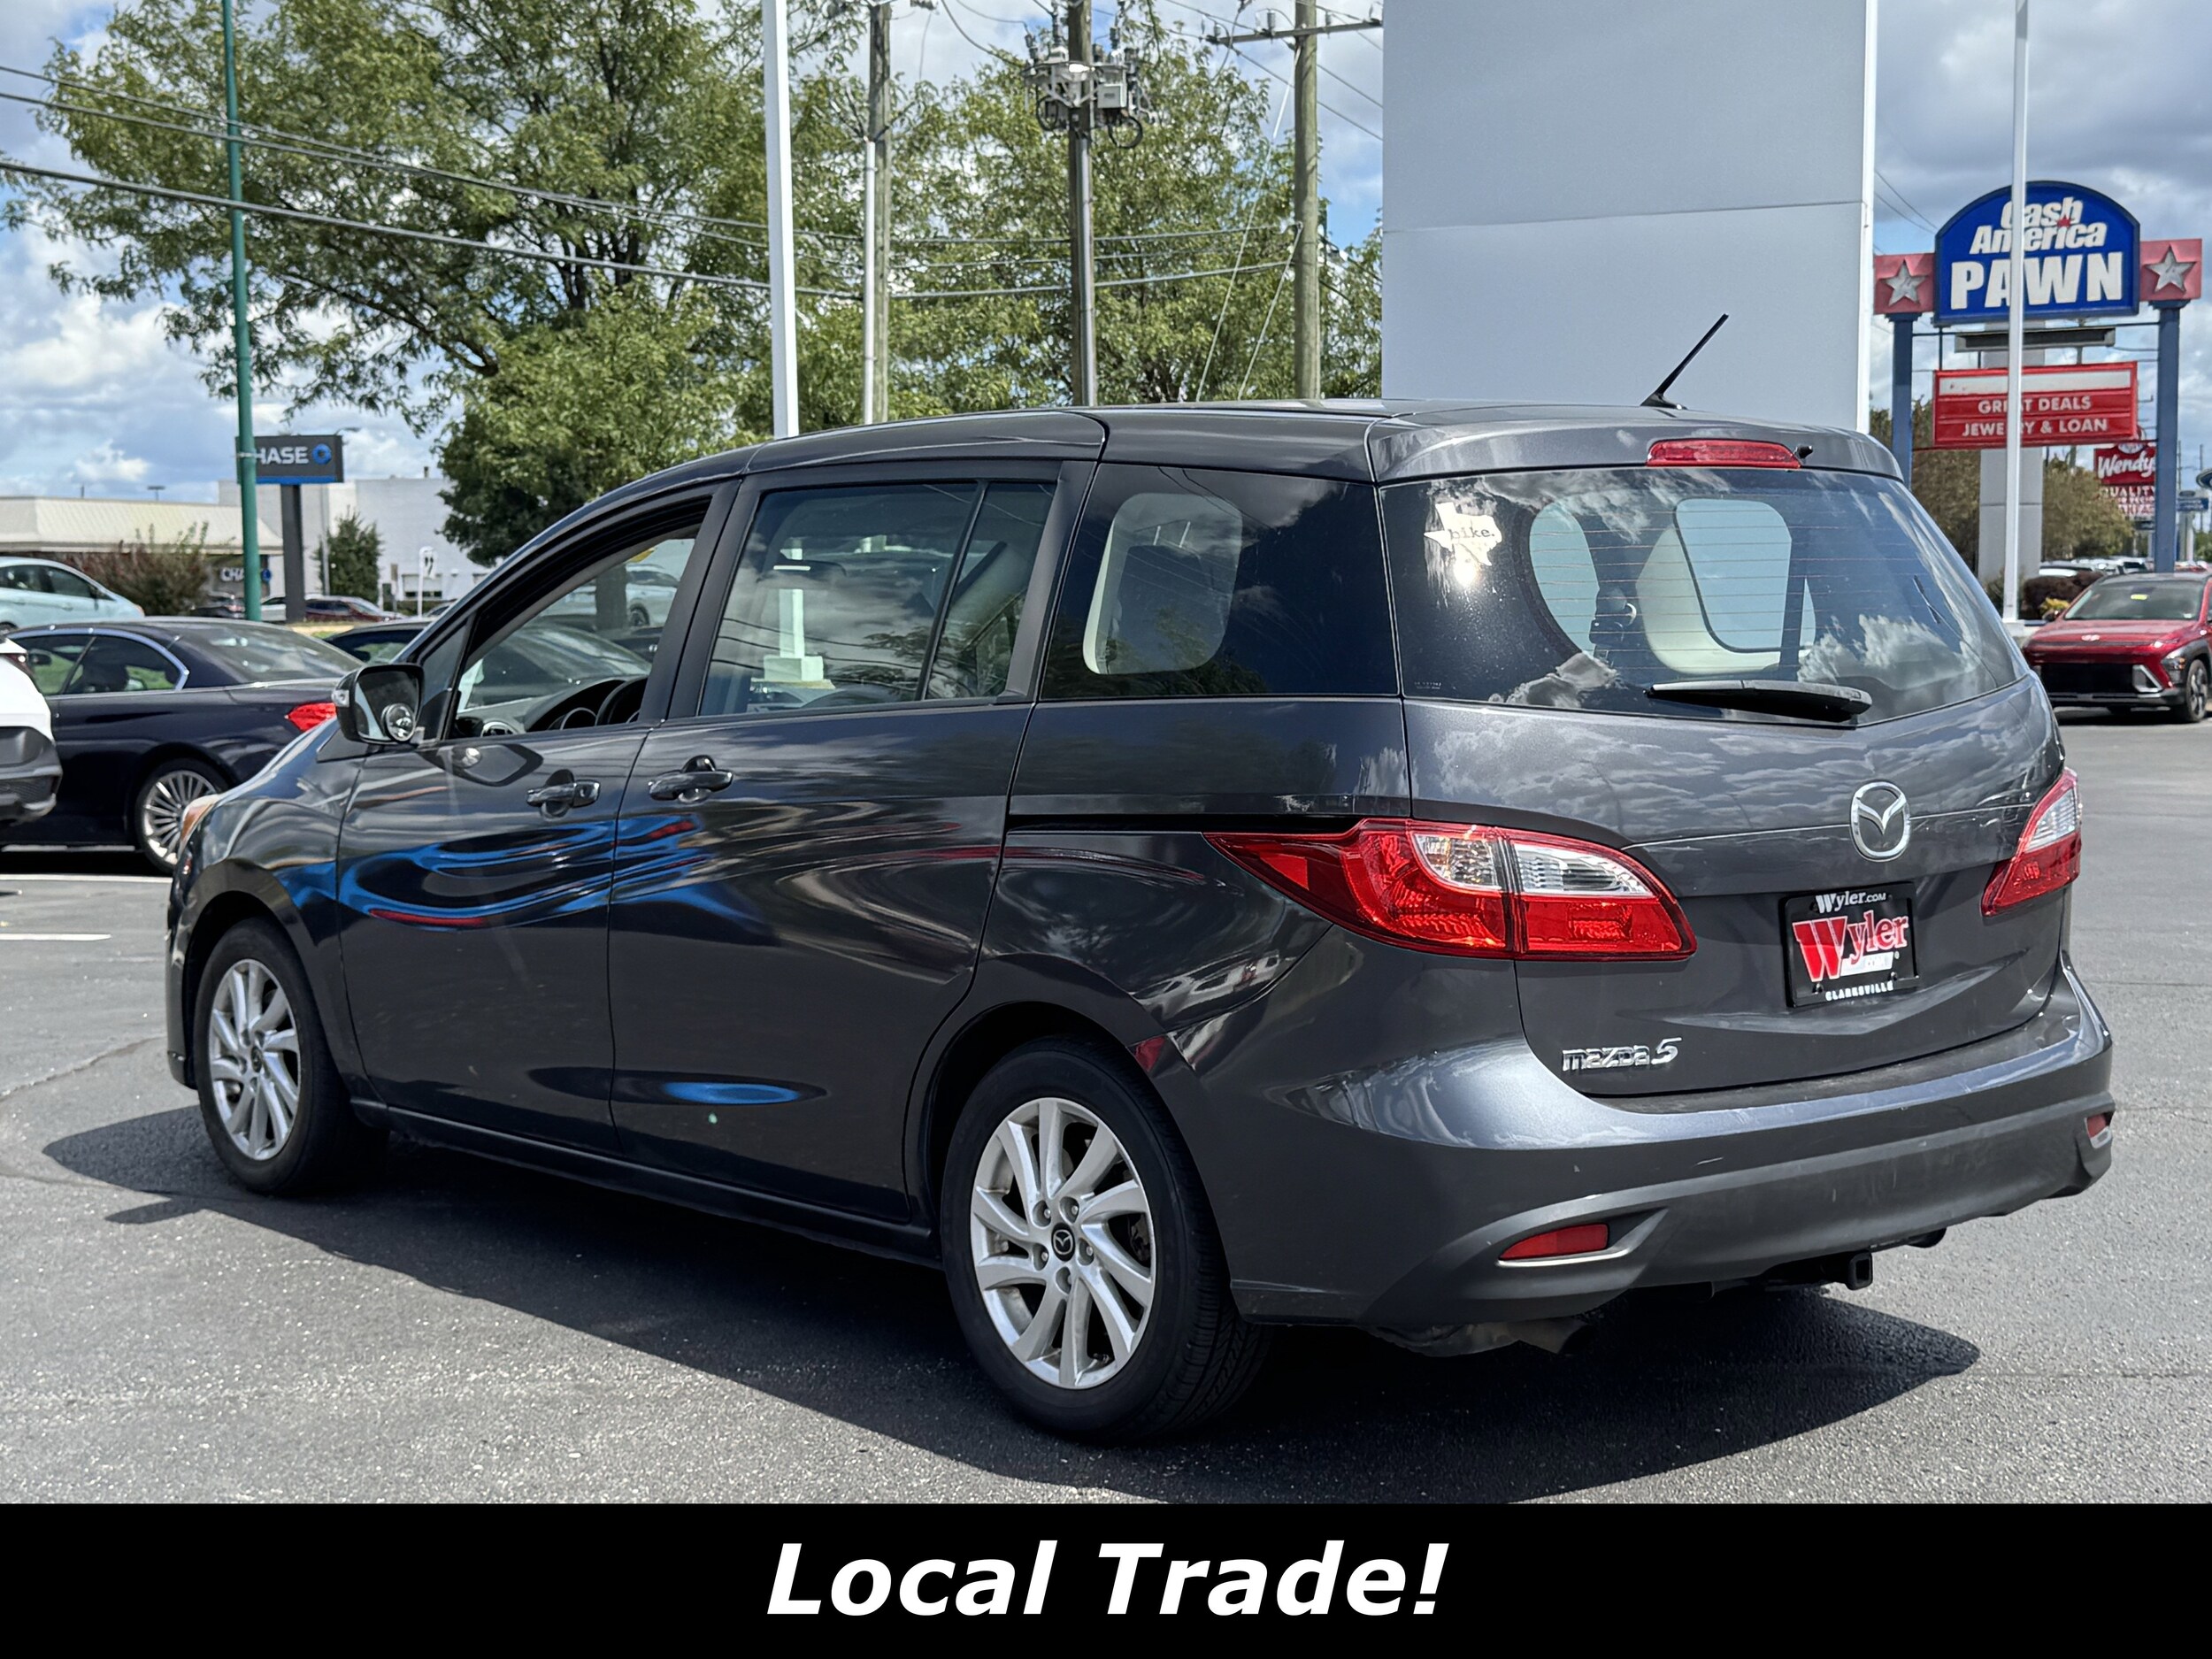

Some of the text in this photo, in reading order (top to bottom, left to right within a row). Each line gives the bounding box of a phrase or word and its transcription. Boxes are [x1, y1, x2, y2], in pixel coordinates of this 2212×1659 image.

[2001, 196, 2084, 230] Cash
[1969, 221, 2108, 255] America
[1949, 251, 2123, 311] PAWN
[1978, 396, 2092, 414] GRT DEALS
[1962, 418, 2108, 437] JEWEY & LOAN
[256, 446, 310, 465] HASE
[1792, 910, 1909, 982] Wyler
[1825, 980, 1894, 1002] CLARKSVILLE
